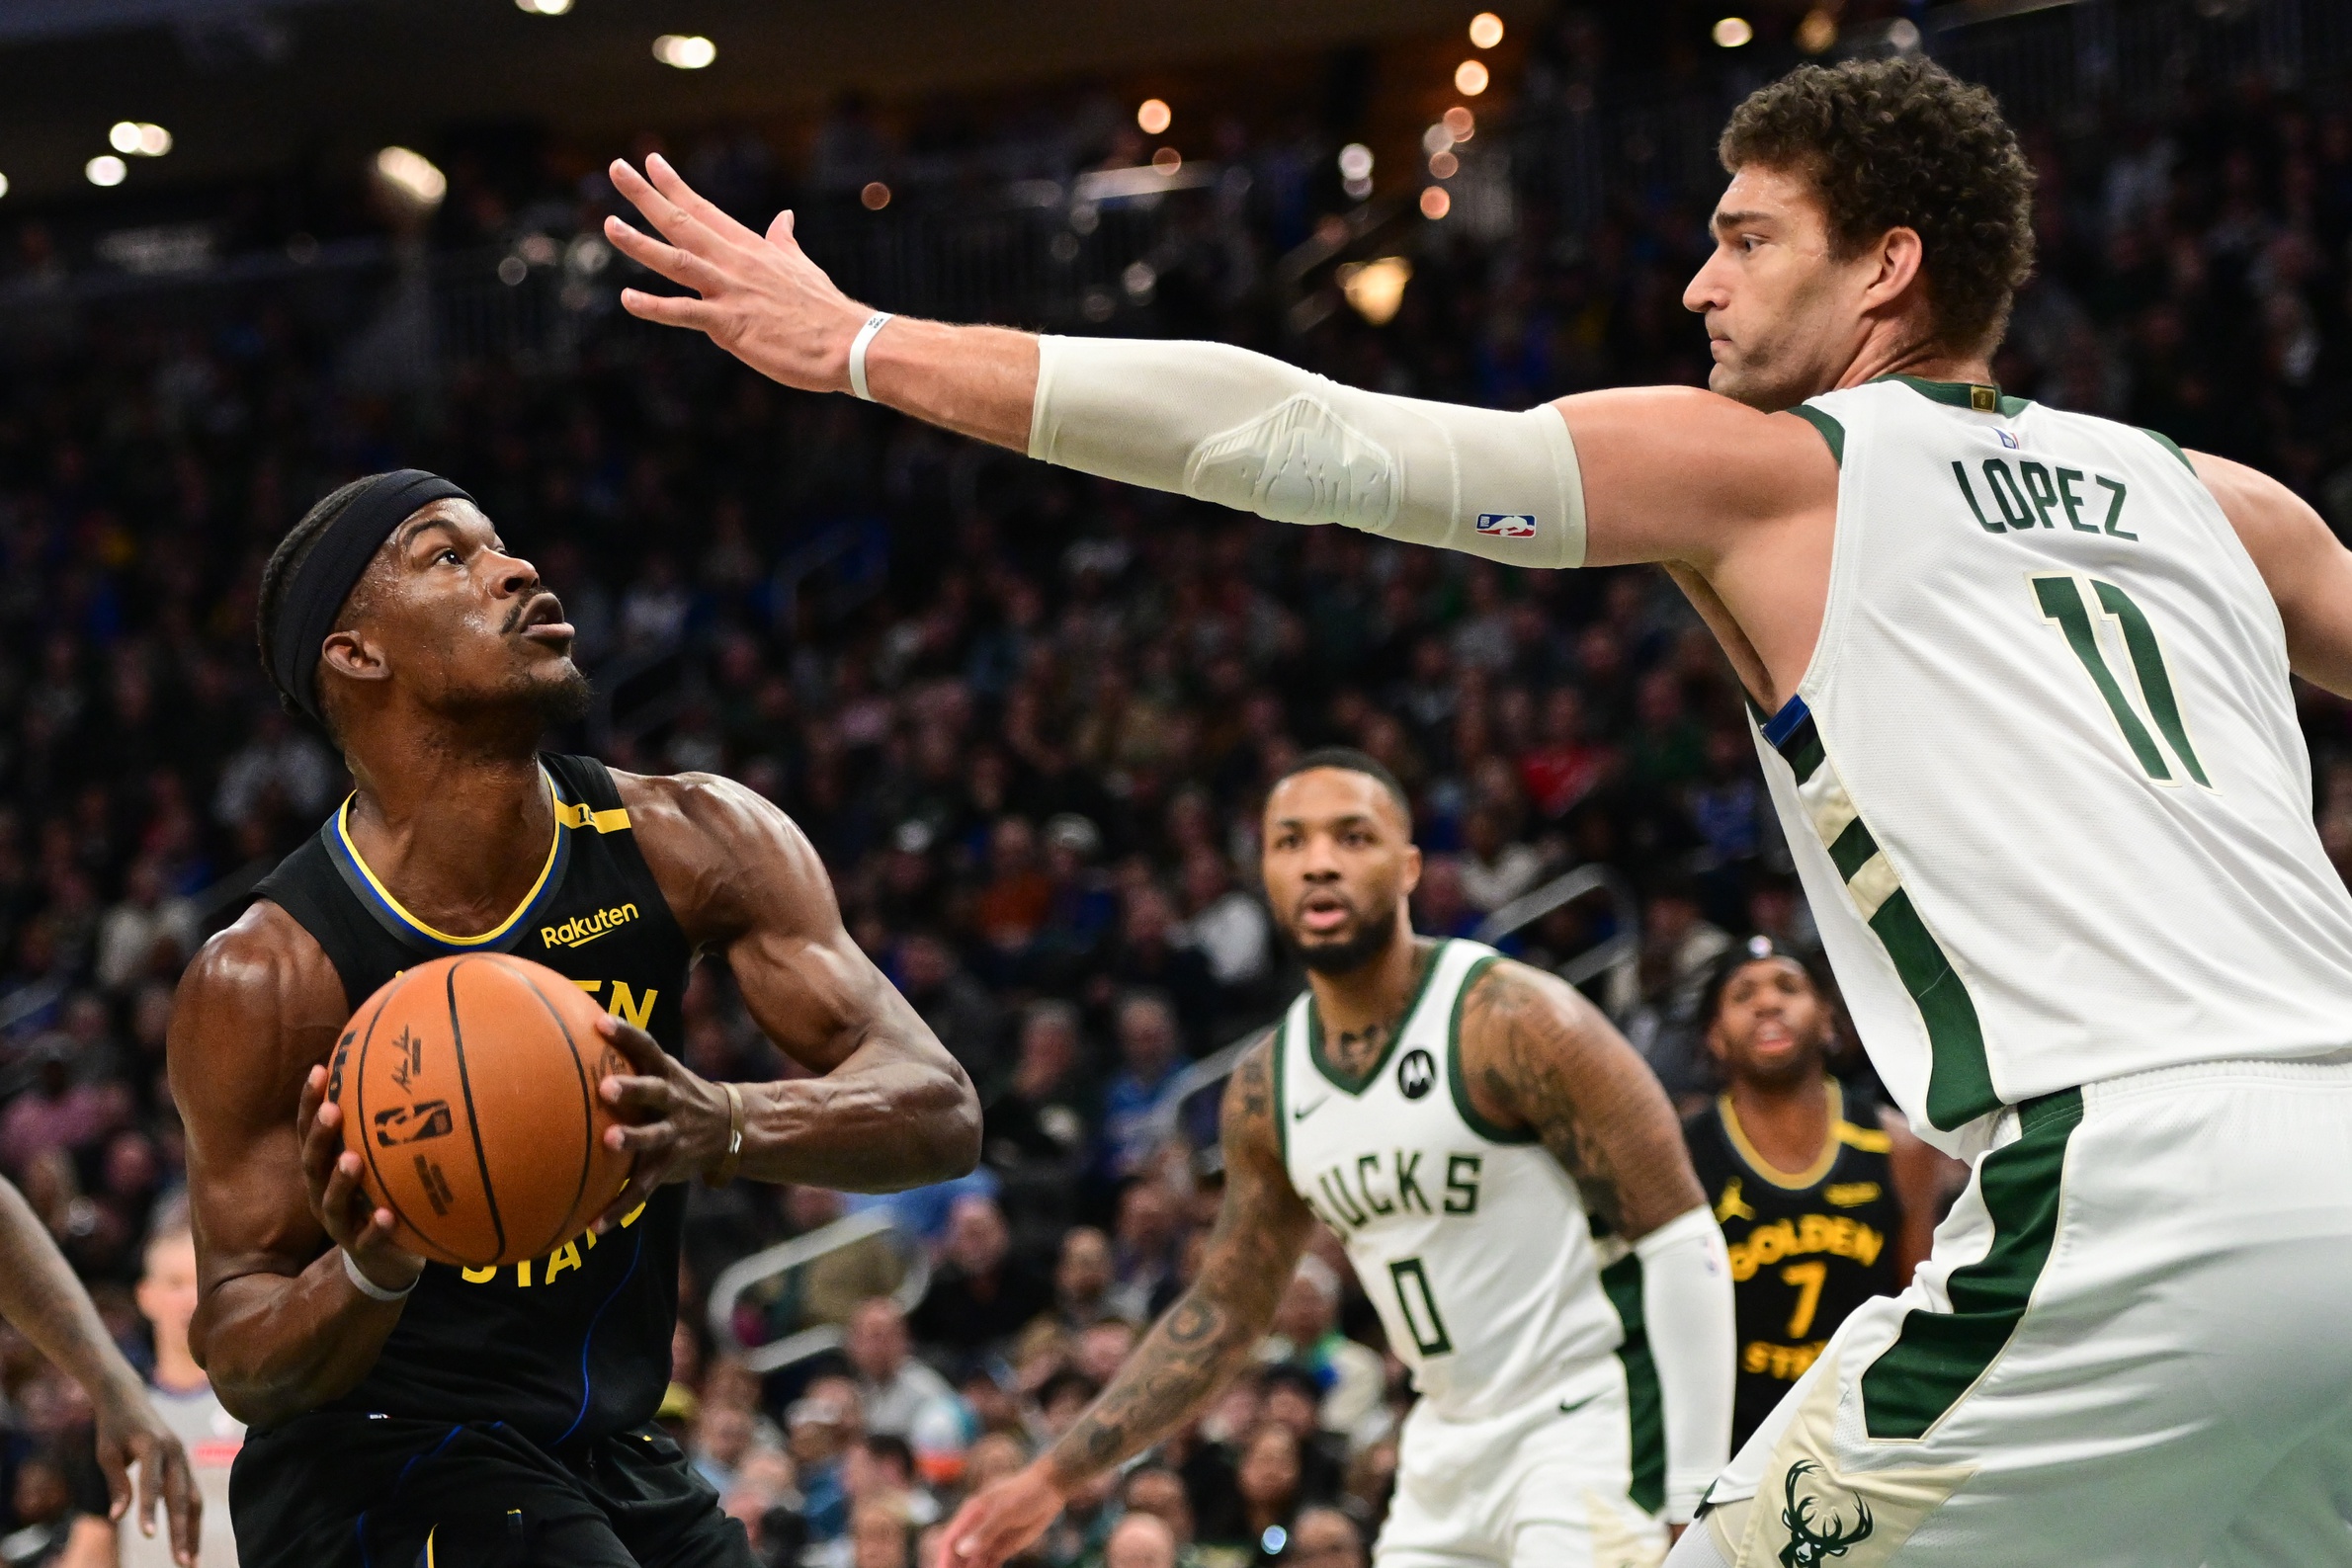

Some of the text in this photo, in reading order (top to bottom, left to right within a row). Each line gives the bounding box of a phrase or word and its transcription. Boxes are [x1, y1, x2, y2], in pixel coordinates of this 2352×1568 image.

[1952, 458, 2139, 541] LOPEZ
[2025, 571, 2222, 795] 11
[541, 903, 639, 949] Rakuten
[1389, 1258, 1453, 1357] 0
[1782, 1260, 1826, 1339] 7
